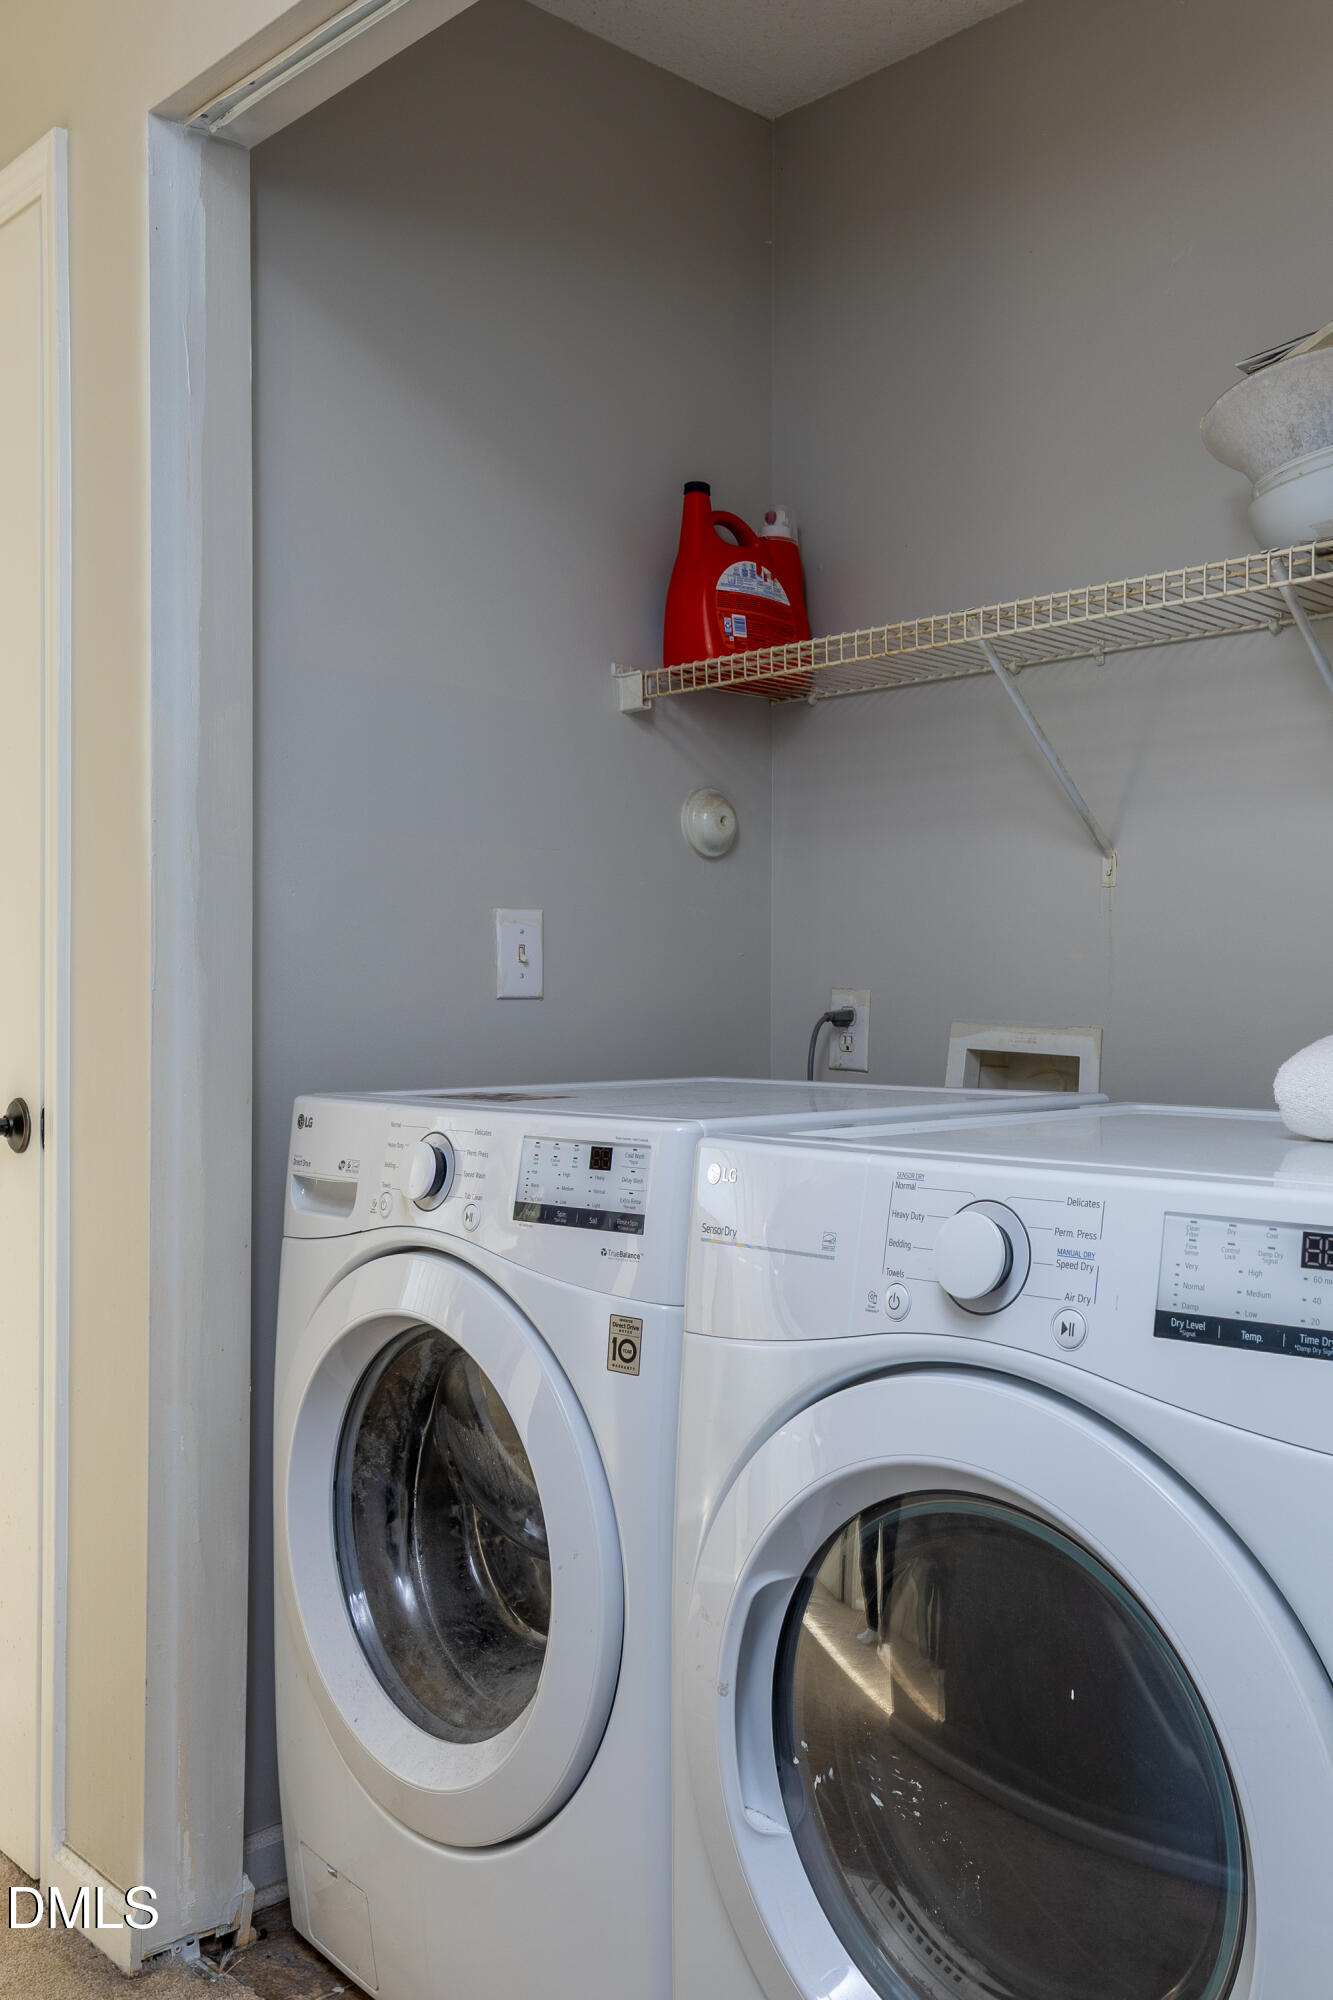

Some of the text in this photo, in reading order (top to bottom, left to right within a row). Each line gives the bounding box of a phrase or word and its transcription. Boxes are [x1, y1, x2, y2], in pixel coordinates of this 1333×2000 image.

[474, 1128, 492, 1137] Delicates
[894, 1181, 917, 1191] Normal
[1066, 1197, 1101, 1209] Delicates
[891, 1210, 926, 1223] Heavy Duty
[701, 1222, 737, 1239] Sensor Dry
[1054, 1227, 1097, 1240] Perm. Press
[888, 1238, 912, 1251] Bedding
[608, 1249, 641, 1260] TrueBalance
[1057, 1248, 1095, 1259] MANUAL DRY
[1056, 1259, 1094, 1274] Speed Dry
[1184, 1262, 1199, 1272] Very
[886, 1267, 905, 1278] Towels
[1248, 1269, 1263, 1279] High
[1313, 1275, 1323, 1284] 60
[1182, 1281, 1205, 1291] Normal
[1064, 1292, 1091, 1306] Air Dry
[1246, 1289, 1272, 1299] Medium
[1181, 1302, 1199, 1311] Damp
[1312, 1297, 1322, 1305] 40
[1244, 1310, 1258, 1319] Low
[612, 1321, 640, 1332] Direct Drive
[1170, 1317, 1206, 1332] Dry Level
[1310, 1318, 1320, 1327] 20
[1241, 1330, 1264, 1343] Temp.
[1299, 1333, 1320, 1345] Time
[611, 1337, 637, 1364] 10
